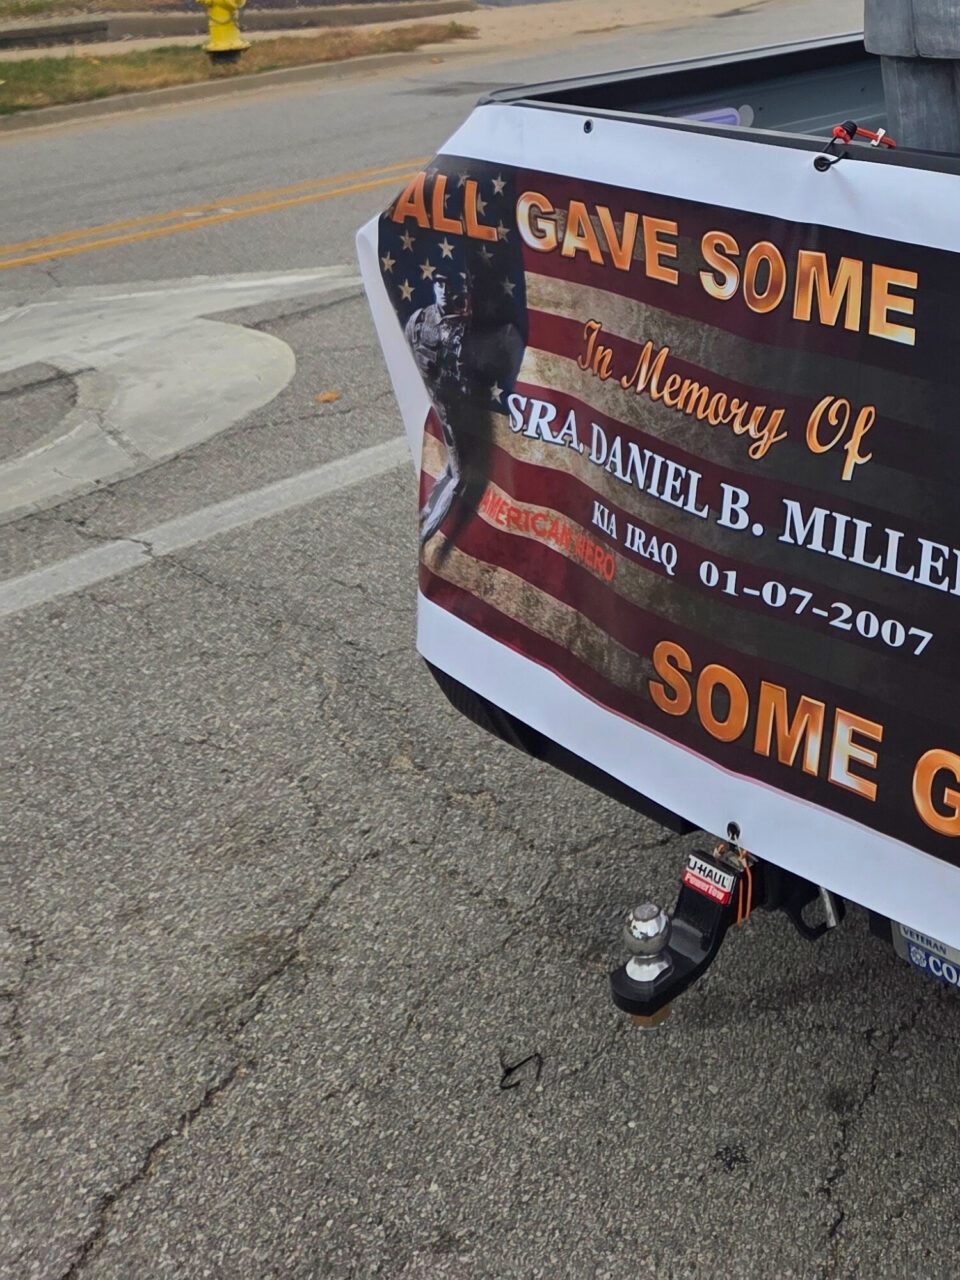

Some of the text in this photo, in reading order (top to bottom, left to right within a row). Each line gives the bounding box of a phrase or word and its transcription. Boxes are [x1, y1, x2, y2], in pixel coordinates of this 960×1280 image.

[392, 170, 919, 347] ALL GAVE SOME
[507, 392, 584, 454] SRA.
[589, 422, 710, 519] DANIEL
[717, 483, 765, 537] B.
[577, 318, 878, 481] In Memory Of
[478, 487, 617, 582] AMERICAN HERO
[592, 500, 935, 657] KIA IRAQ 01-07-2007
[647, 640, 885, 803] SOME
[687, 857, 727, 889] U-HAUL
[902, 926, 948, 956] VETERAN
